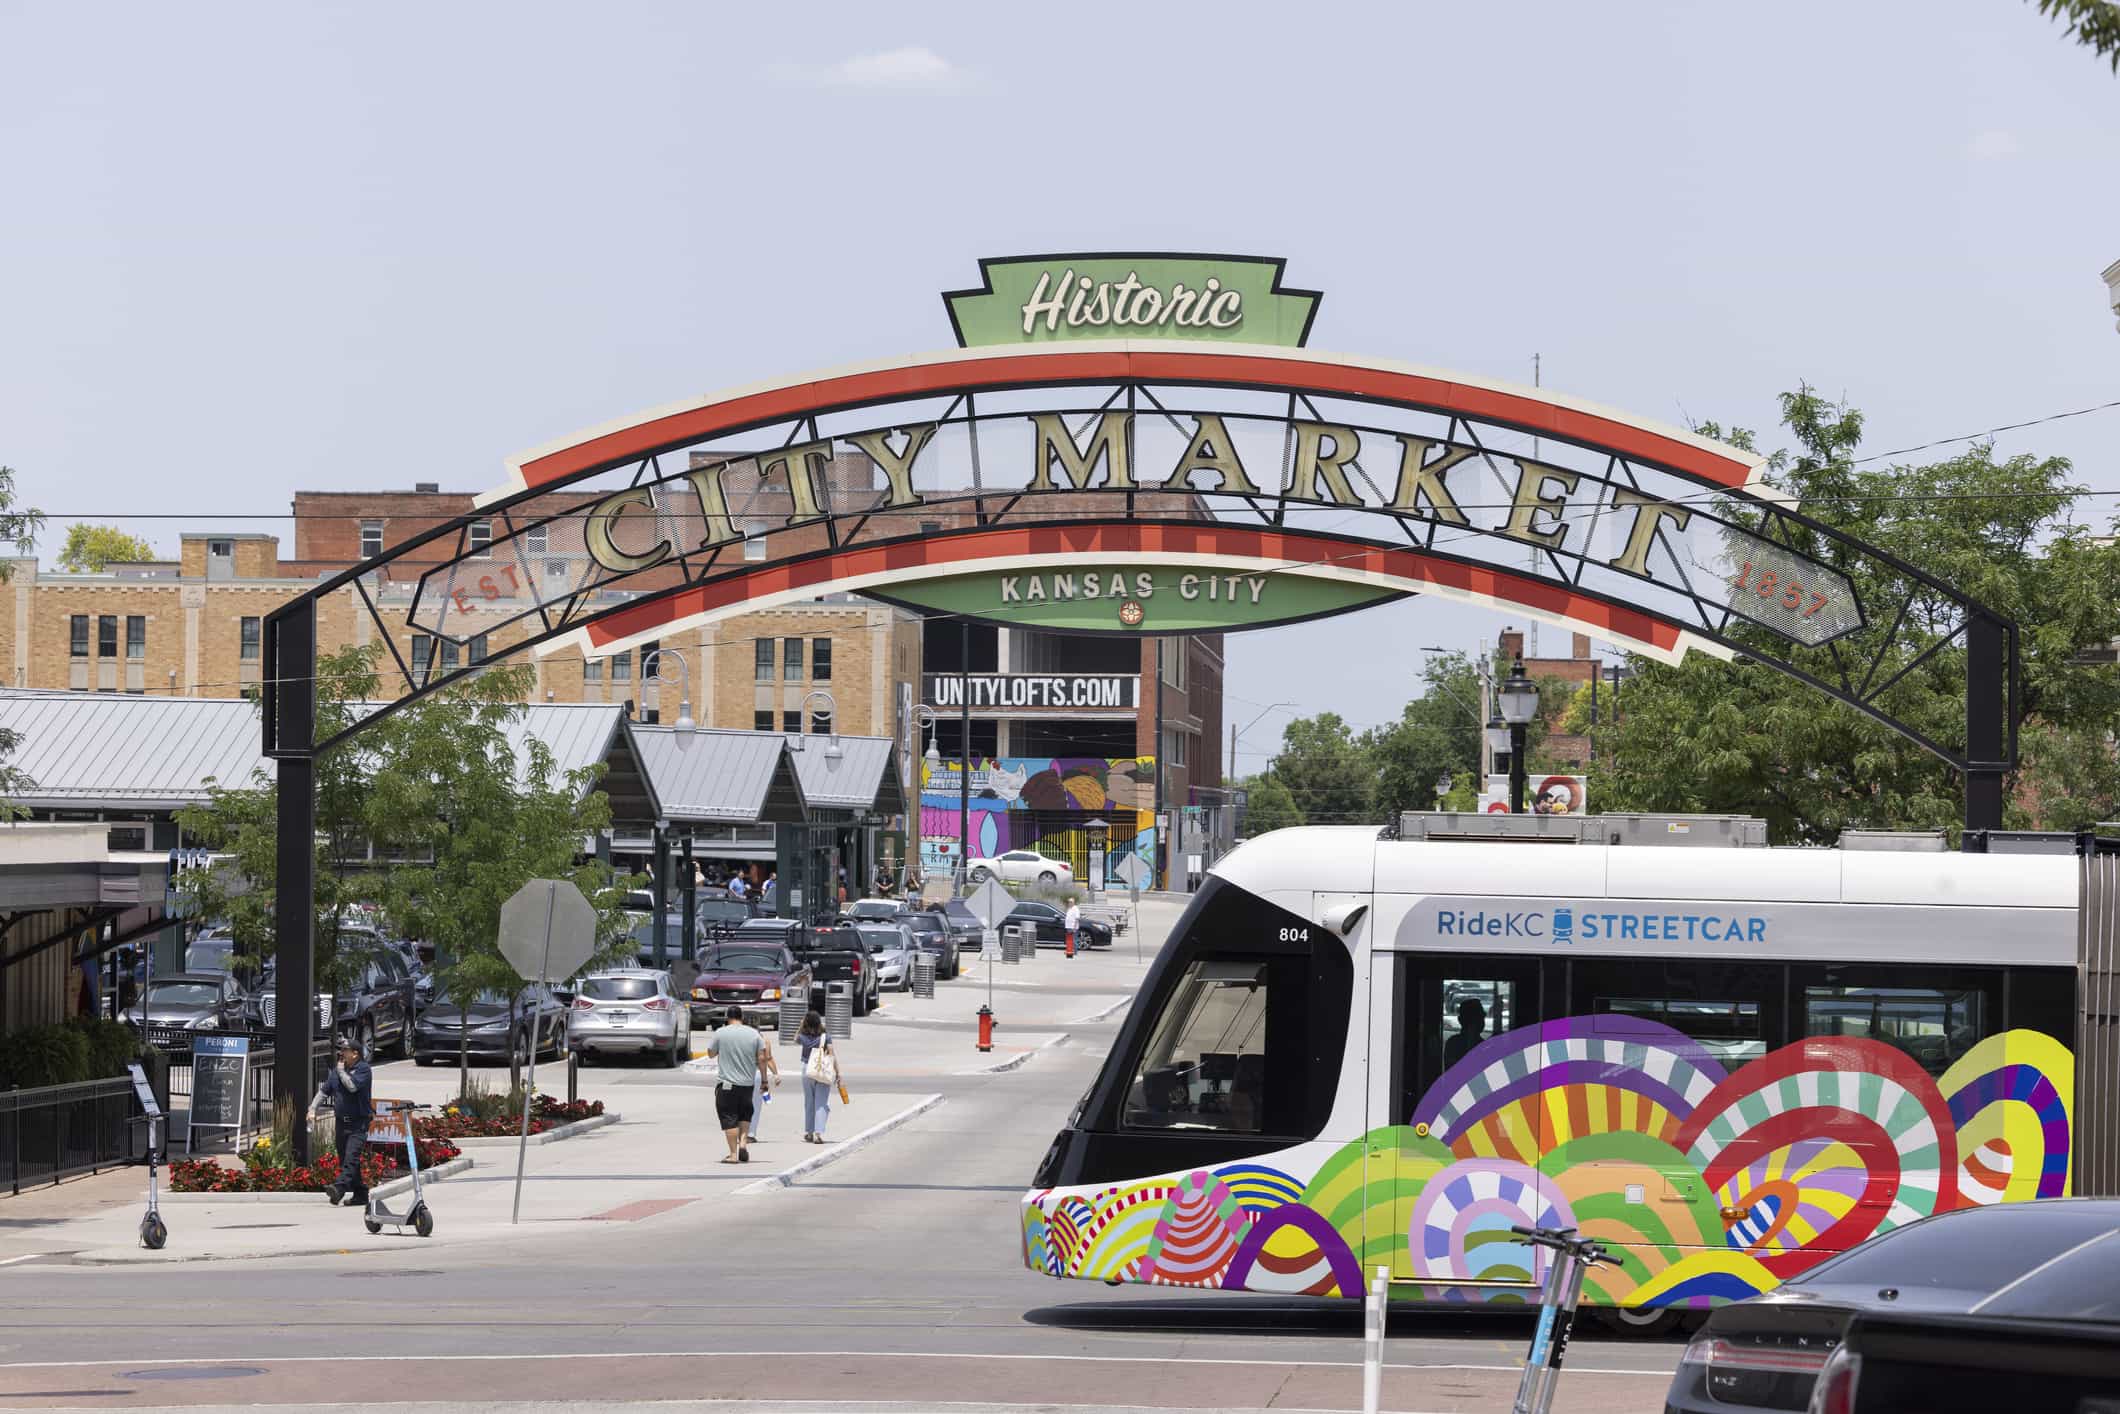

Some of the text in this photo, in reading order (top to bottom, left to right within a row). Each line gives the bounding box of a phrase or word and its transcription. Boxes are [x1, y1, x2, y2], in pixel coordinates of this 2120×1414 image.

[1021, 269, 1243, 335] Historic
[583, 410, 1692, 579] CITY MARKET
[1001, 572, 1268, 603] KANSAS CITY
[1734, 560, 1829, 618] 1857
[1279, 927, 1309, 942] 804
[1437, 910, 1767, 942] RideKC STREETCAR
[205, 1036, 238, 1048] PERONI
